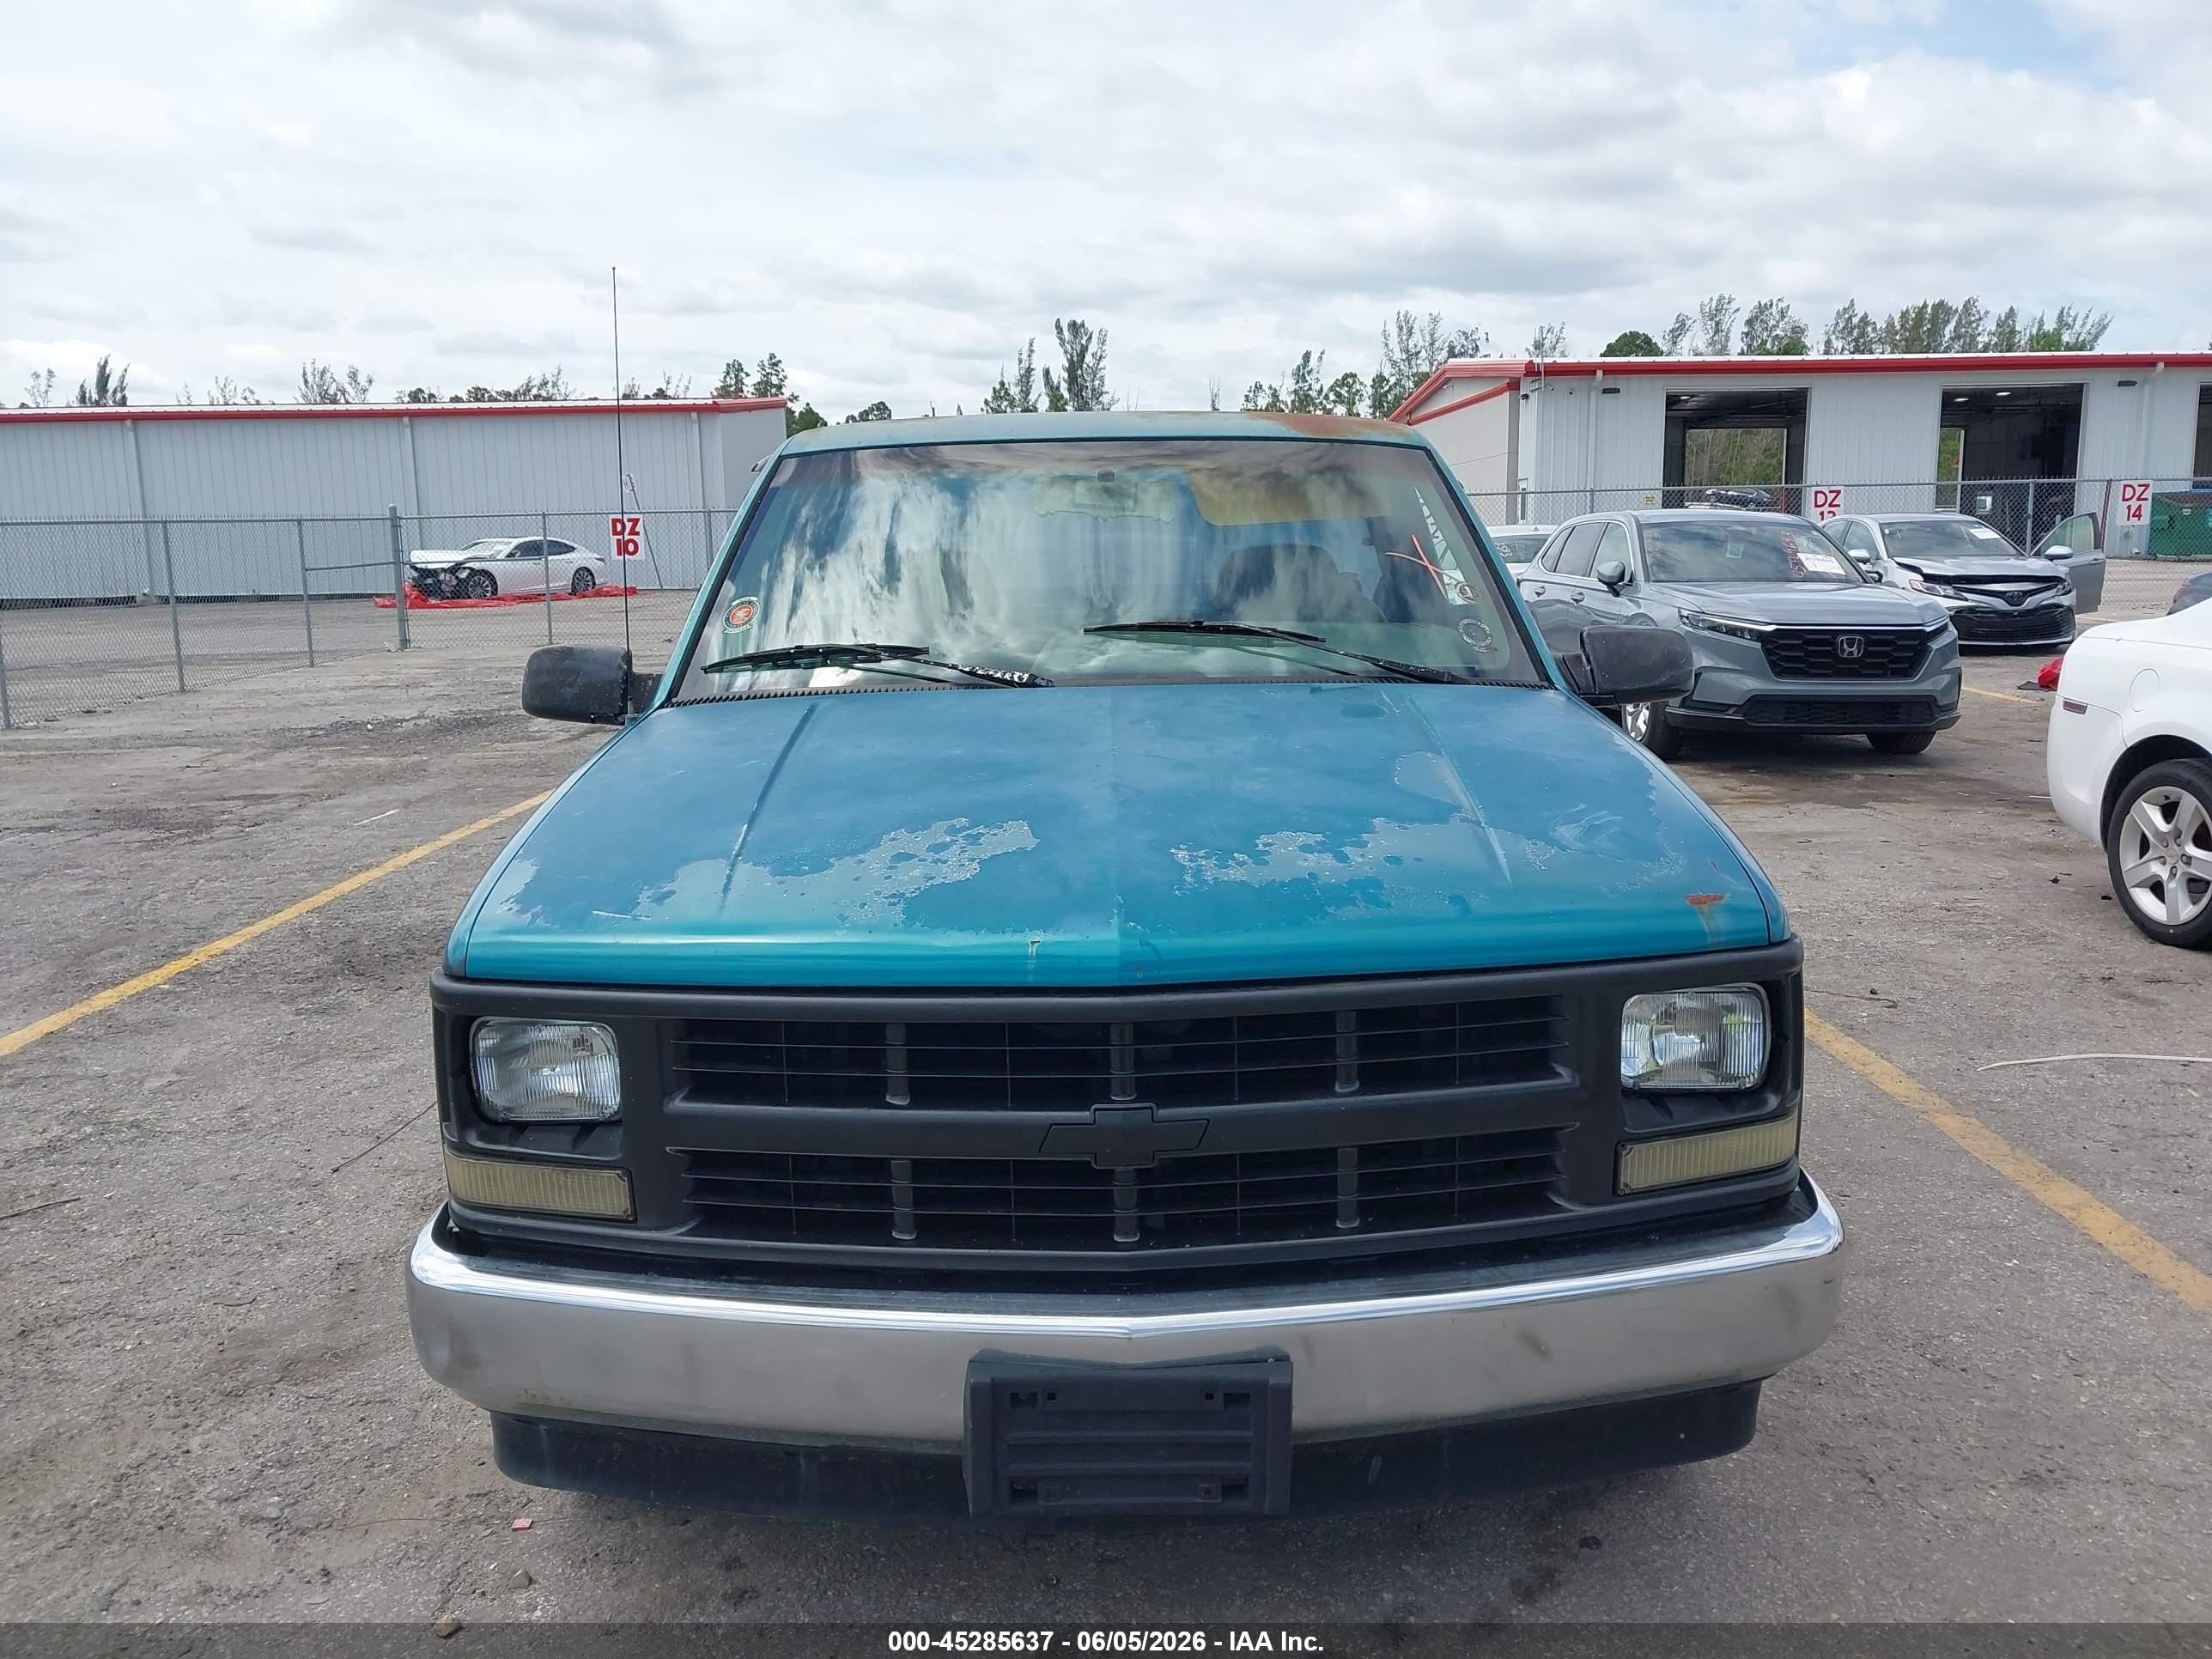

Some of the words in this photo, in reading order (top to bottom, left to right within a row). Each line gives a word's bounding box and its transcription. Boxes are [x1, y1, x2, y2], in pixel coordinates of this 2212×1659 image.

[1814, 489, 1842, 508] DZ
[2121, 483, 2151, 502] DZ
[2125, 504, 2143, 522] 14
[611, 518, 641, 537] DZ
